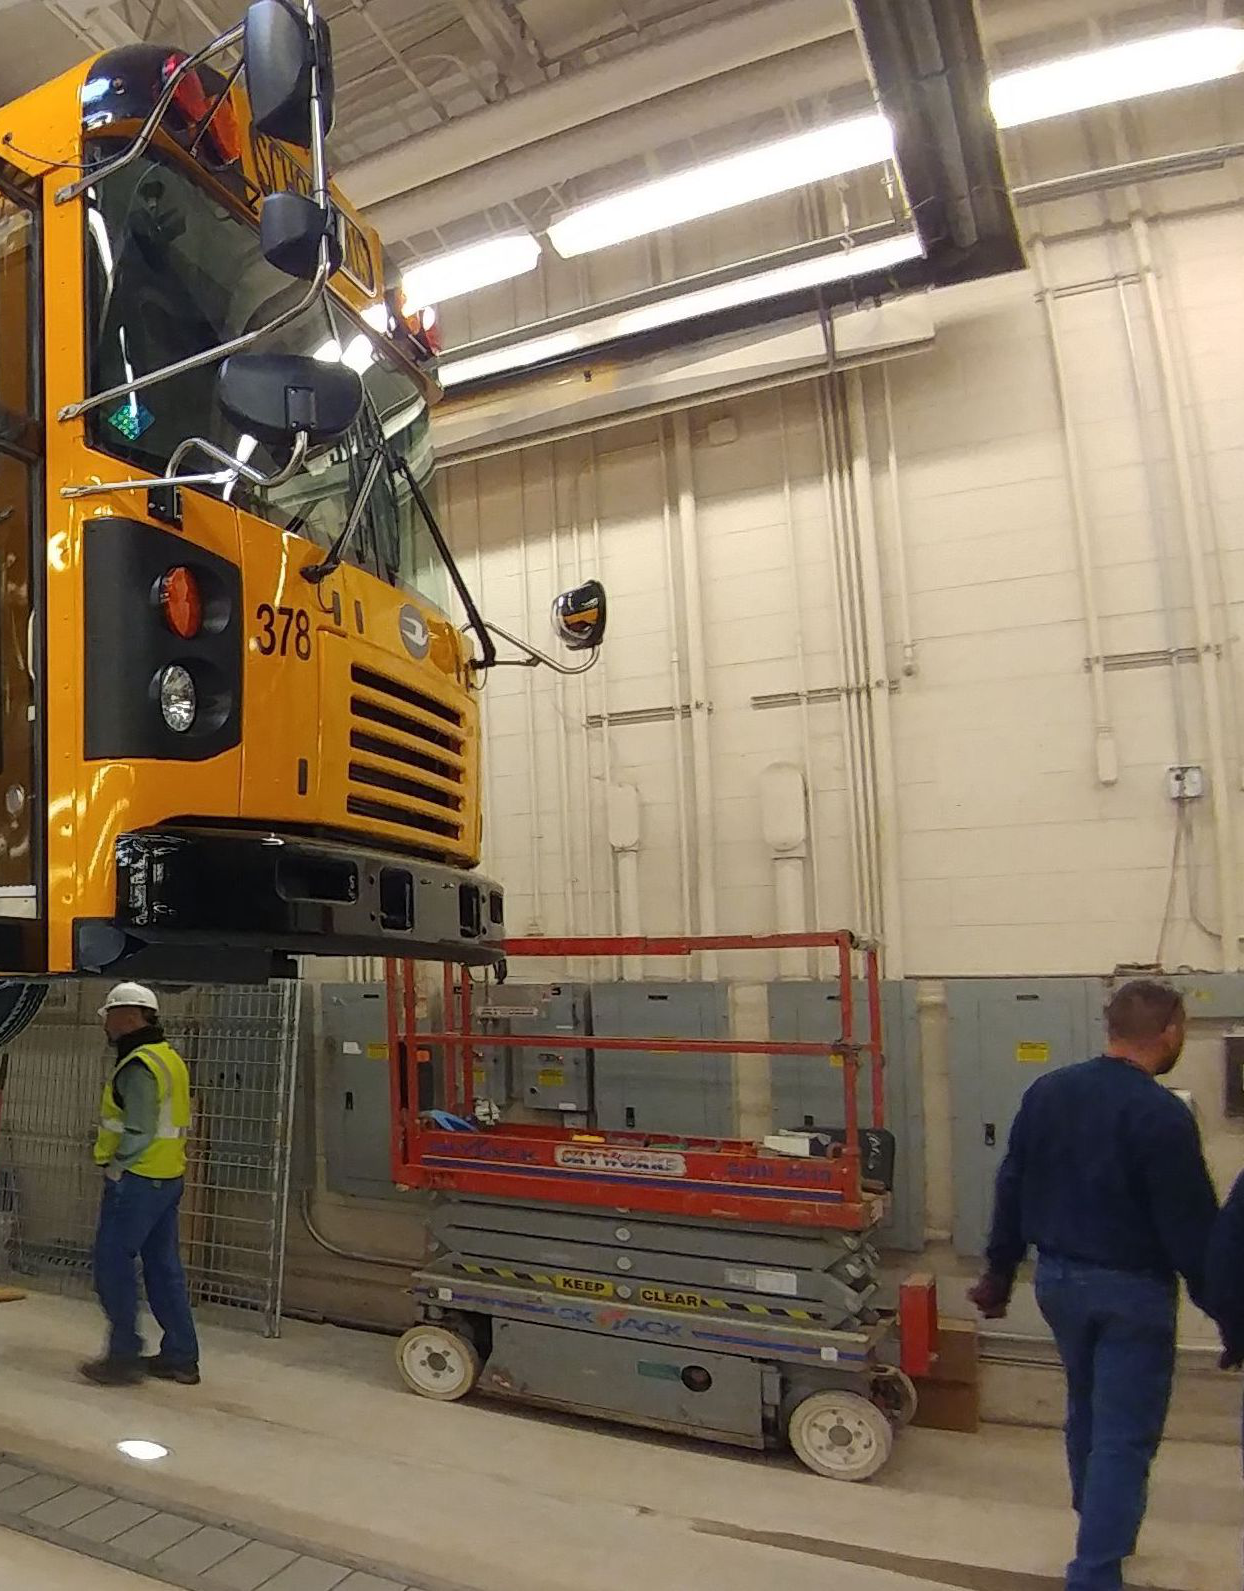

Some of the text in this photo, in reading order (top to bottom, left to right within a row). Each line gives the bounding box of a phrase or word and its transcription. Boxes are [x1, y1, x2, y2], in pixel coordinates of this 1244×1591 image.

[256, 603, 311, 661] 378
[561, 1277, 698, 1307] KEEP CLEAR
